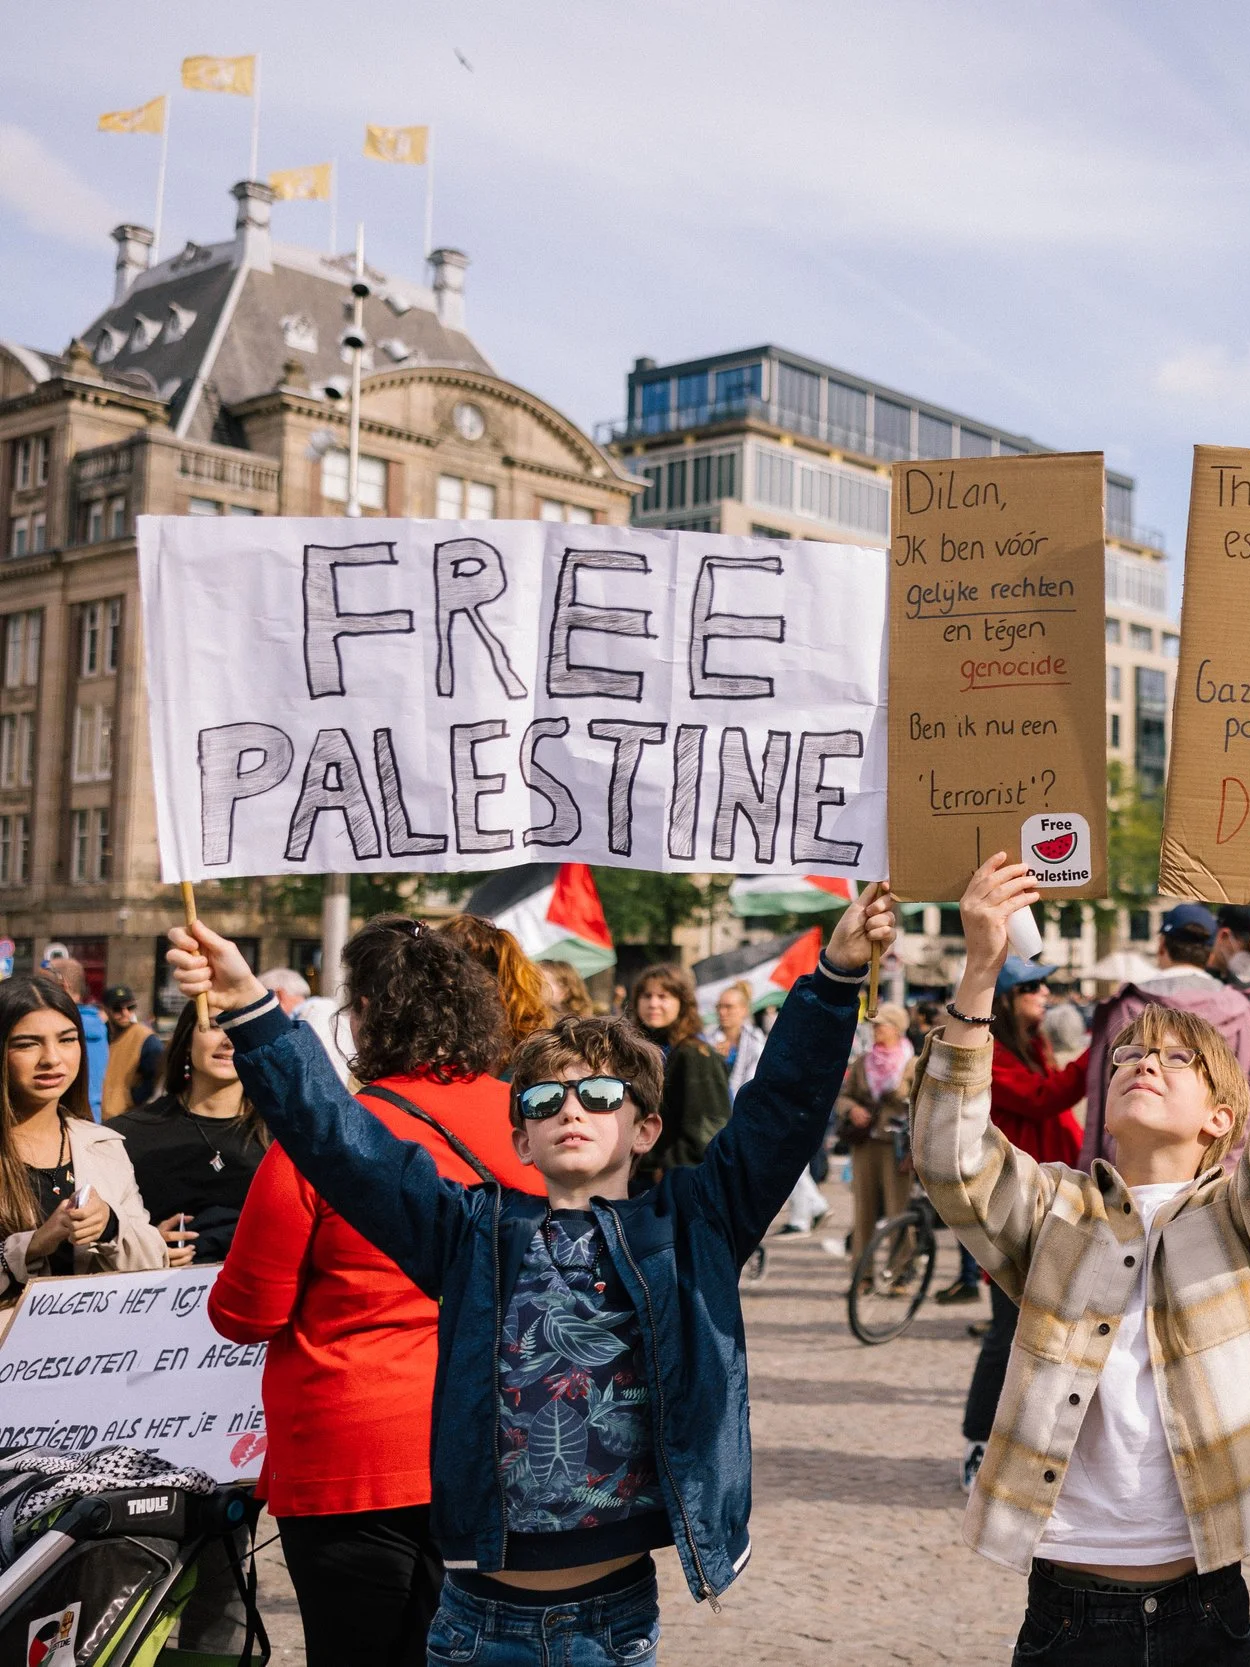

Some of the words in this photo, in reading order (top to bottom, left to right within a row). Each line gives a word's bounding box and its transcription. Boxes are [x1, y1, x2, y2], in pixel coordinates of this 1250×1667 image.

[940, 533, 985, 563] ben
[995, 530, 1049, 557] vóór
[990, 576, 1075, 600] rechten
[302, 537, 787, 702] FREE
[943, 624, 972, 643] en
[984, 618, 1046, 652] tégen
[960, 651, 1068, 693] genocide
[909, 712, 946, 741] Ben
[954, 714, 977, 738] ik
[986, 719, 1014, 737] nu
[1021, 719, 1058, 737] een
[198, 716, 866, 867] PALESTINE
[1040, 818, 1073, 832] Free
[1026, 868, 1089, 882] Palestine
[119, 1287, 168, 1315] HET
[101, 1417, 143, 1442] ALS
[144, 1415, 191, 1440] HET
[127, 1495, 169, 1516] THULE
